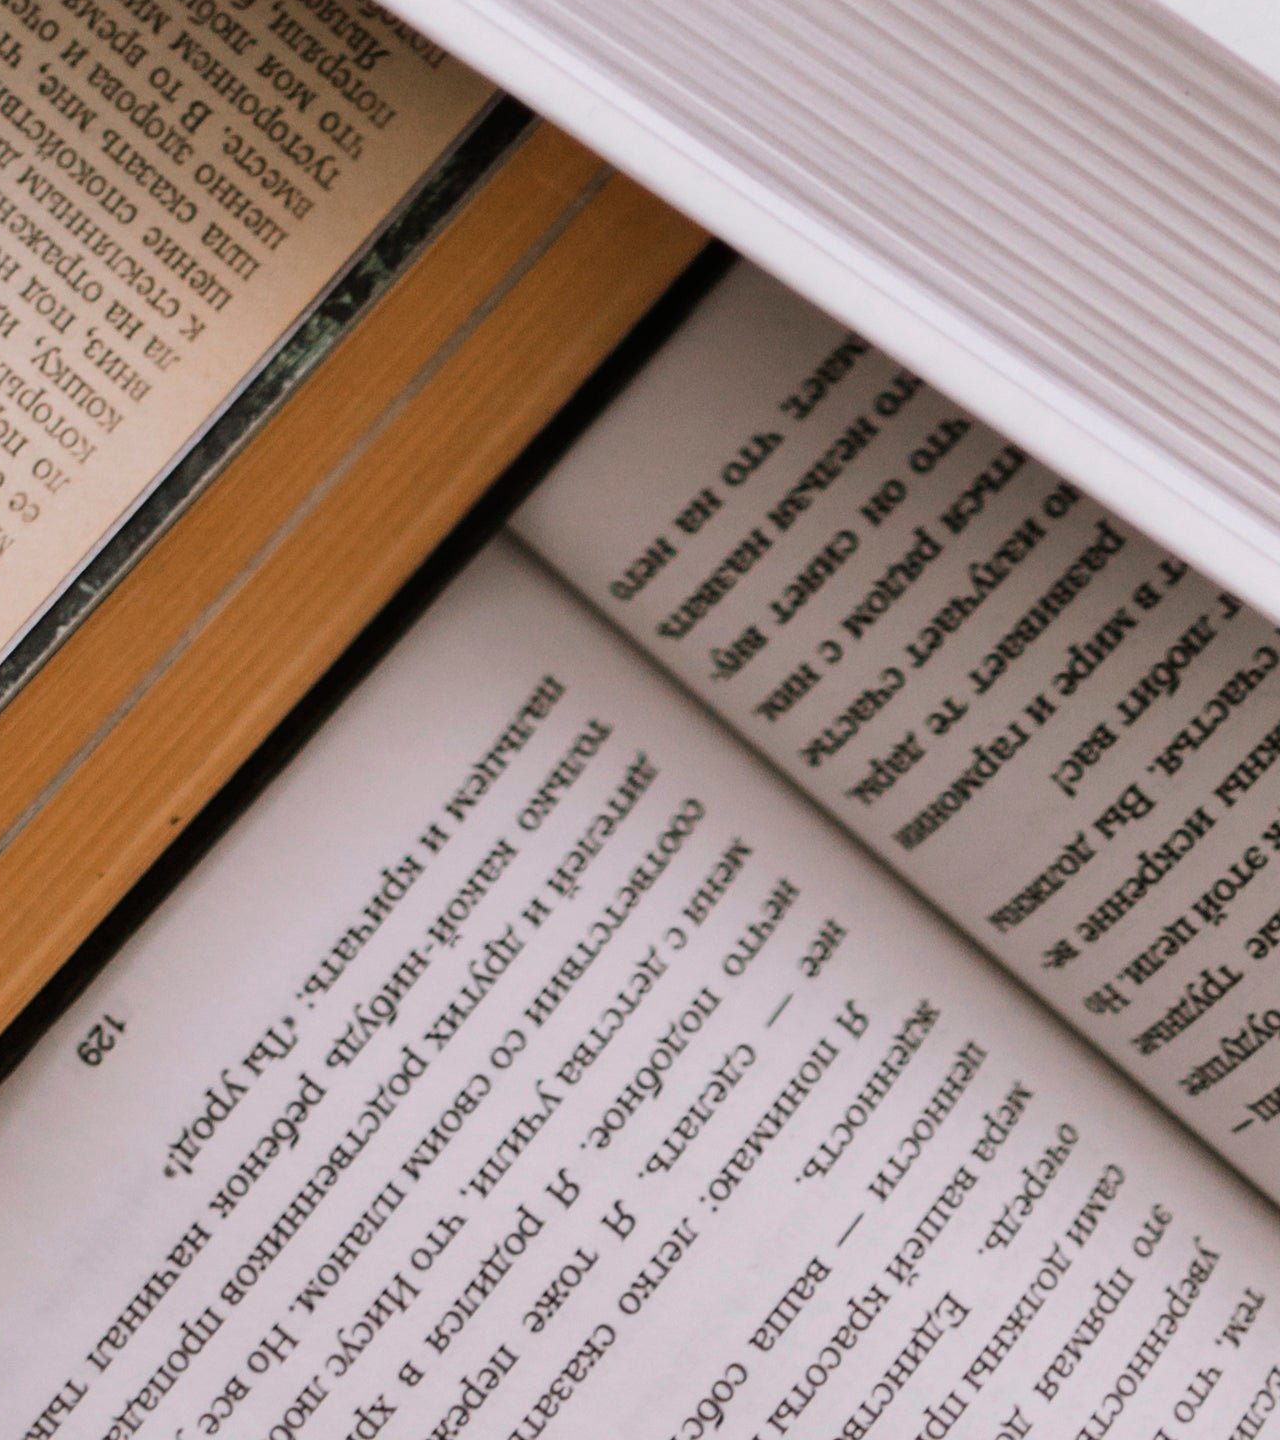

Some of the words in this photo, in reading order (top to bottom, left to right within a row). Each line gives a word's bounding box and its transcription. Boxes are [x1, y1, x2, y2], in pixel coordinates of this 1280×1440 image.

[442, 673, 568, 824] пальцем
[417, 822, 452, 856] и
[680, 836, 755, 928] меня
[662, 925, 690, 952] с
[75, 1013, 128, 1069] 129
[553, 943, 670, 1087] детства
[457, 1077, 565, 1201] учили,
[409, 1213, 469, 1273] что
[323, 1270, 423, 1379] Иисус
